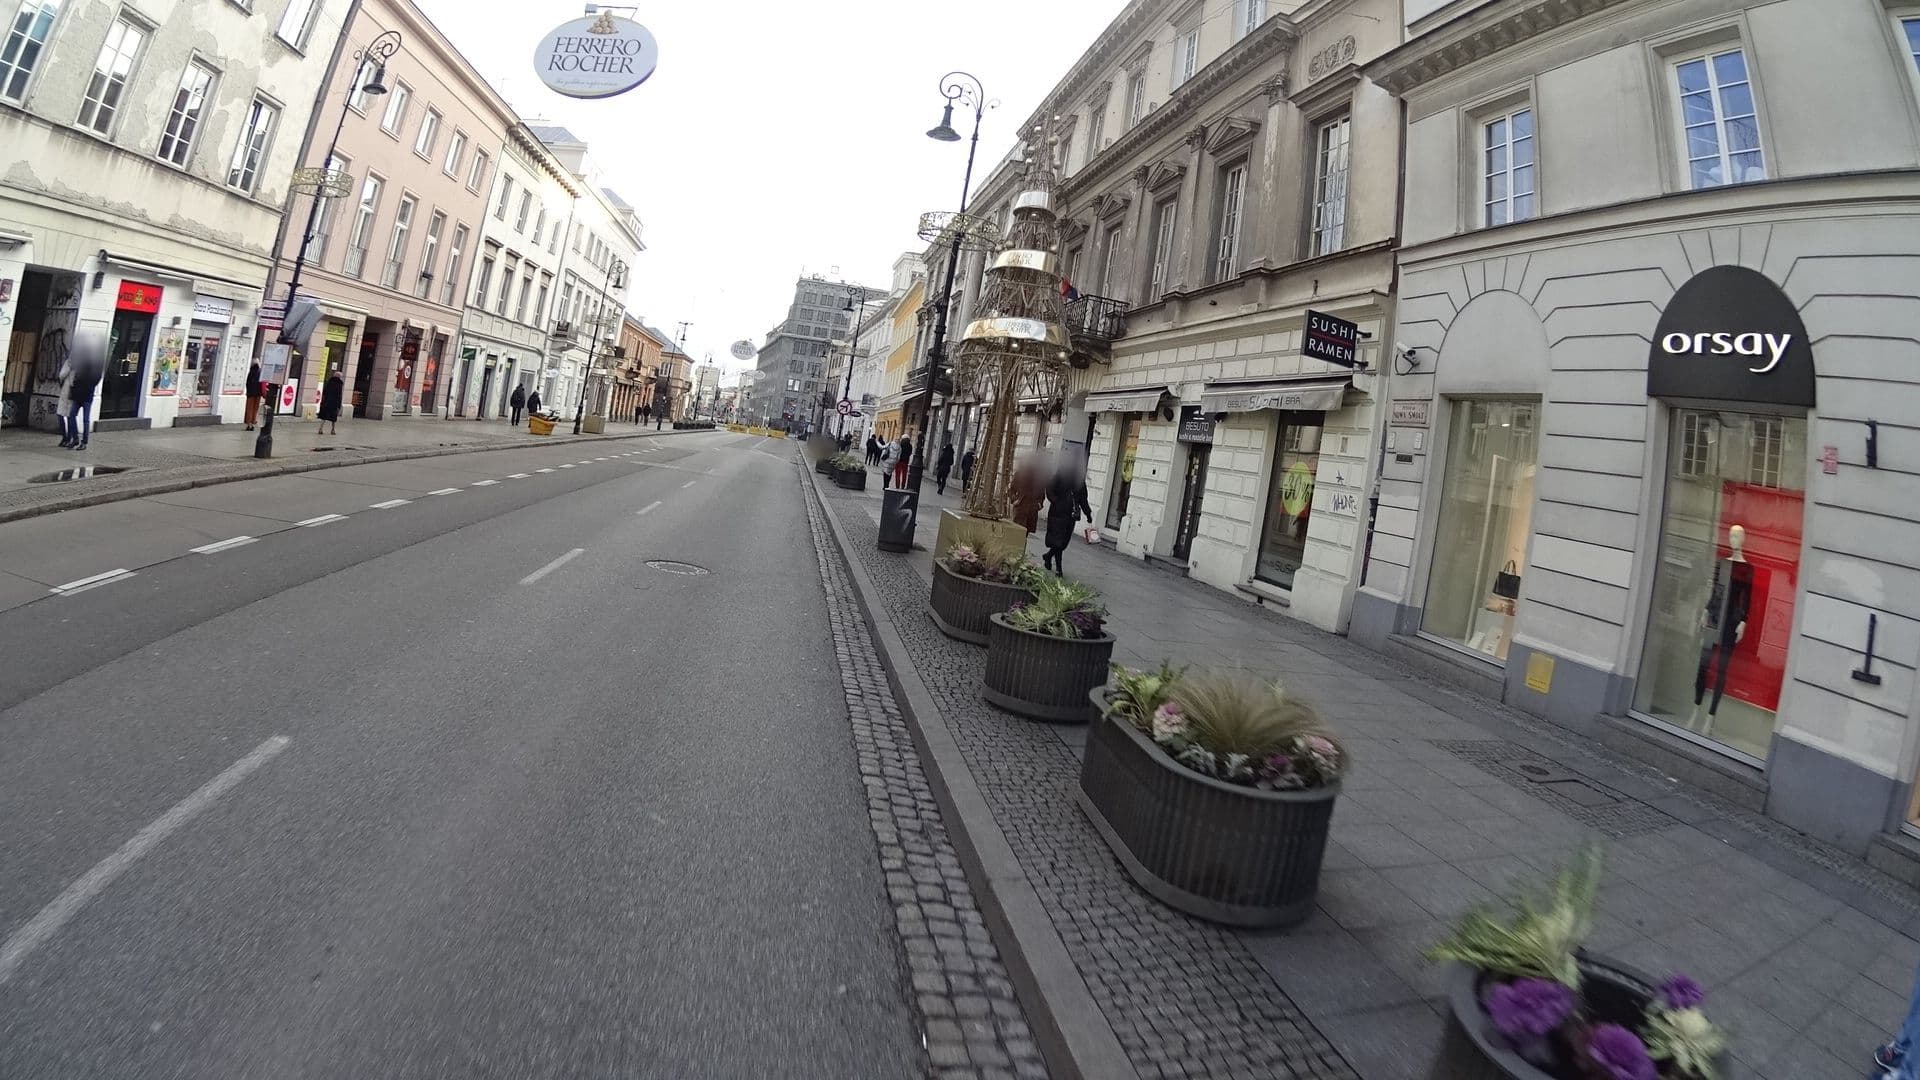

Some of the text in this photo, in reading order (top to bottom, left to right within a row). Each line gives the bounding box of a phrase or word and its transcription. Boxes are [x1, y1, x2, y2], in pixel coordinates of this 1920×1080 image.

[553, 37, 642, 56] FERRERO
[547, 54, 634, 74] ROCHER
[1311, 316, 1354, 341] SUSHI
[1308, 337, 1352, 361] RAMEN
[1662, 332, 1791, 373] orsay
[1185, 421, 1210, 433] BESUTO
